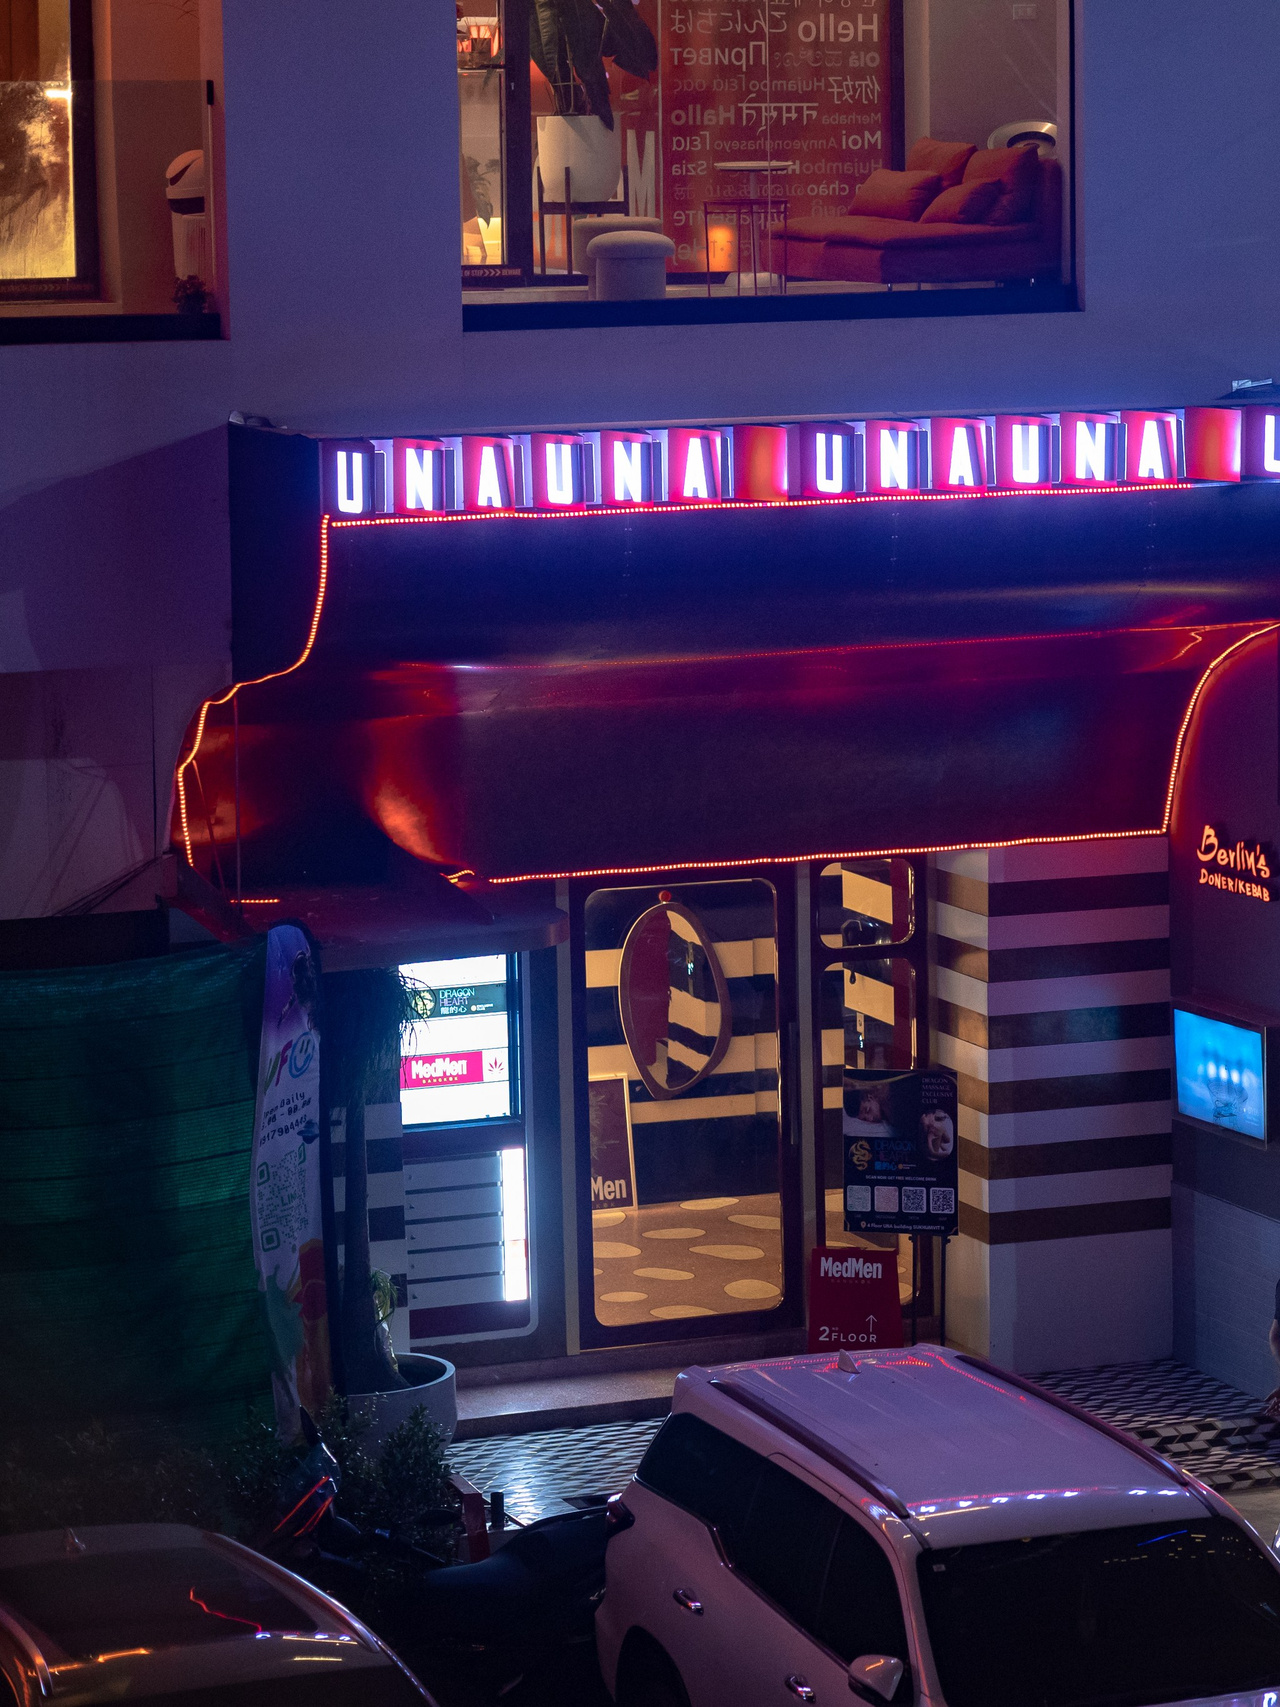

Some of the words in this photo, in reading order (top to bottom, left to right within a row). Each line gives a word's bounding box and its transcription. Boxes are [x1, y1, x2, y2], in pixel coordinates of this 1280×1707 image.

[1197, 825, 1271, 878] Berlin's
[439, 987, 475, 999] DRAGON
[439, 997, 469, 1007] HEART
[411, 1057, 468, 1079] MedMen
[280, 1092, 305, 1108] Daily
[820, 1256, 882, 1279] MedMen
[831, 1333, 877, 1343] FLOOR
